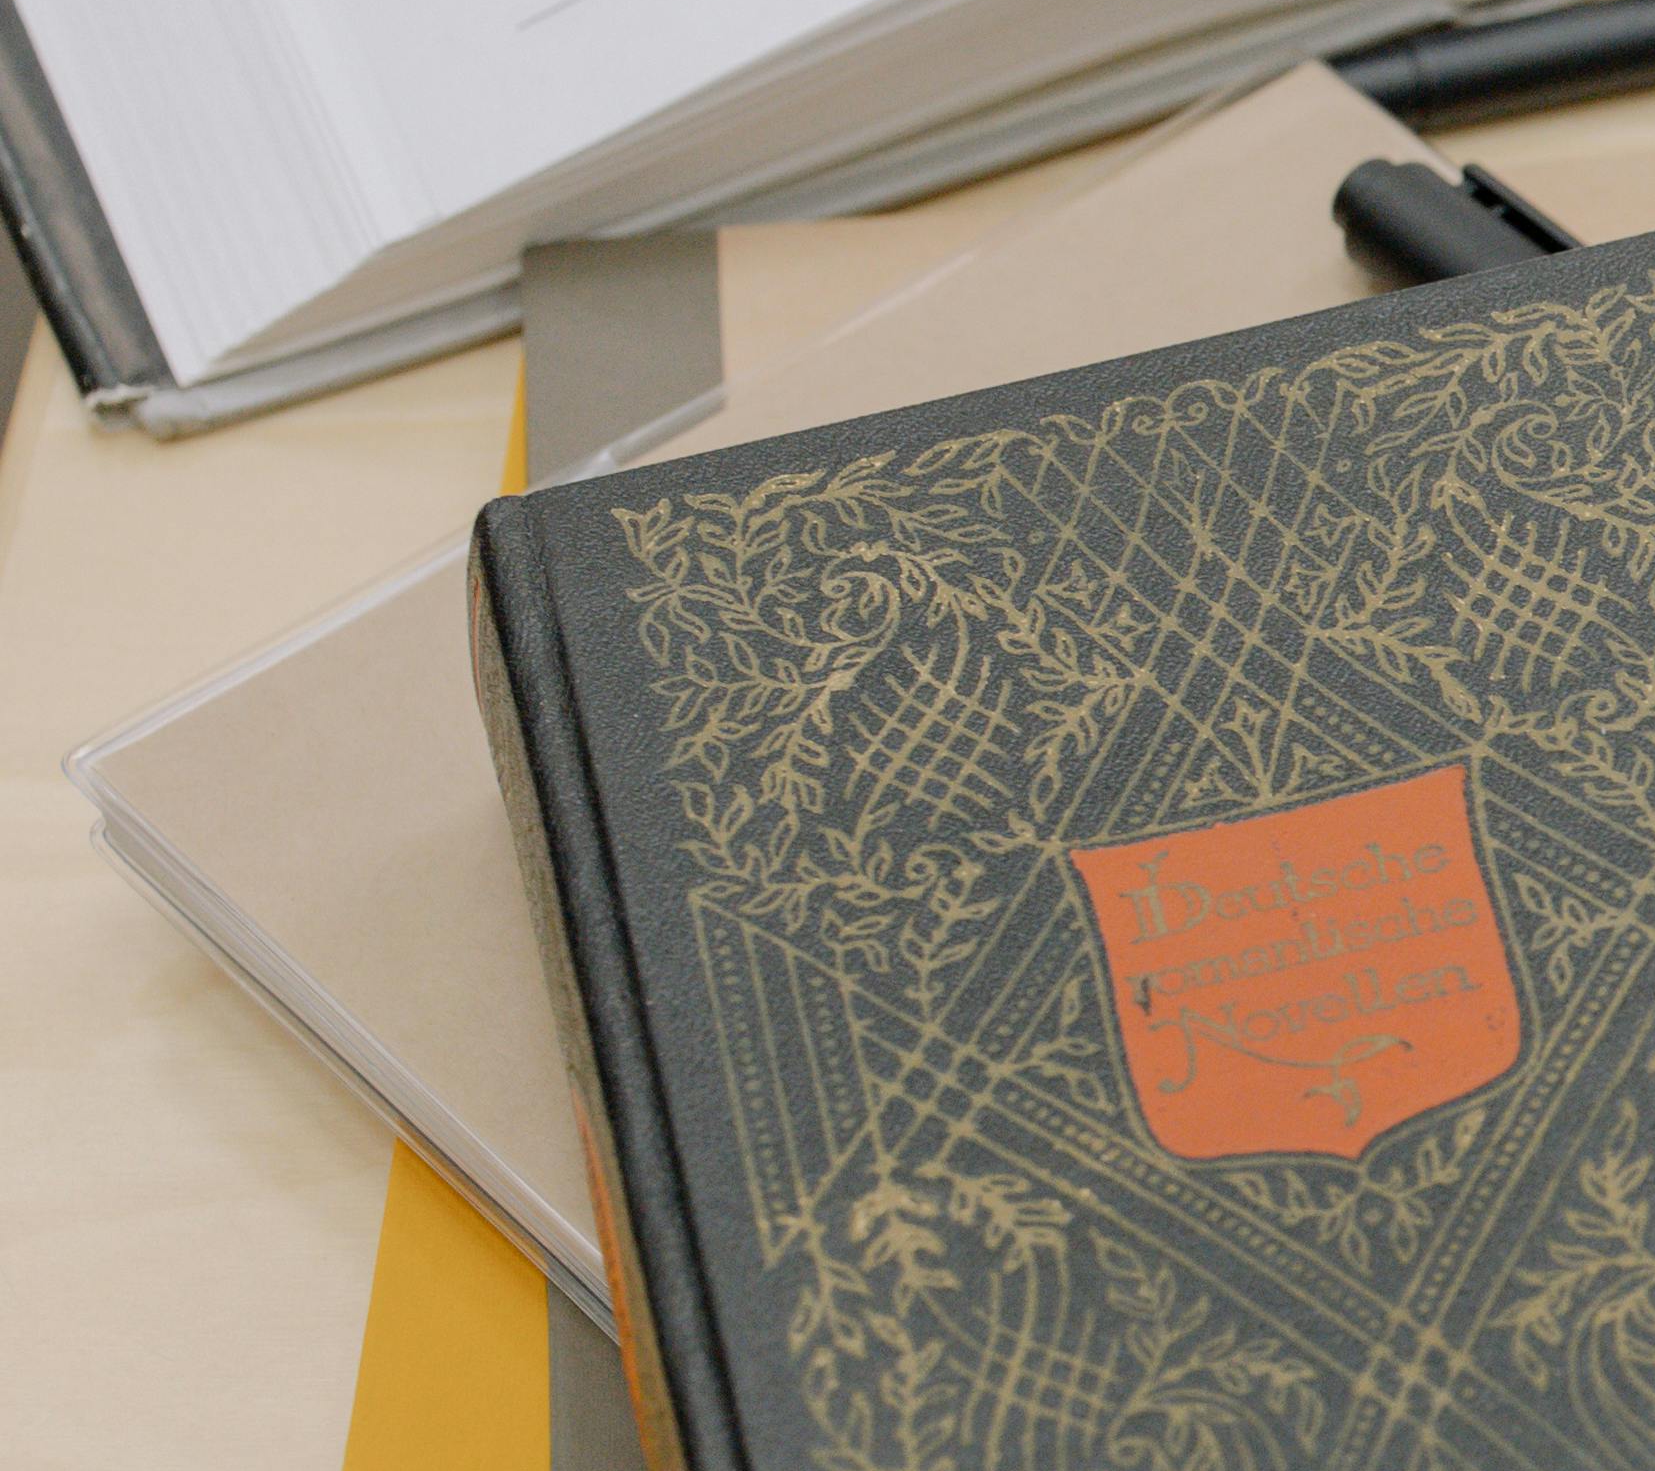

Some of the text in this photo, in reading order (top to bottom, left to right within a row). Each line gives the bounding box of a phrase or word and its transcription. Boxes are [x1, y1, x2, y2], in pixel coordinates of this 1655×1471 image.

[1118, 839, 1451, 946] Deutsche
[1125, 895, 1481, 1006] romantische
[1148, 962, 1483, 1099] Novellen
